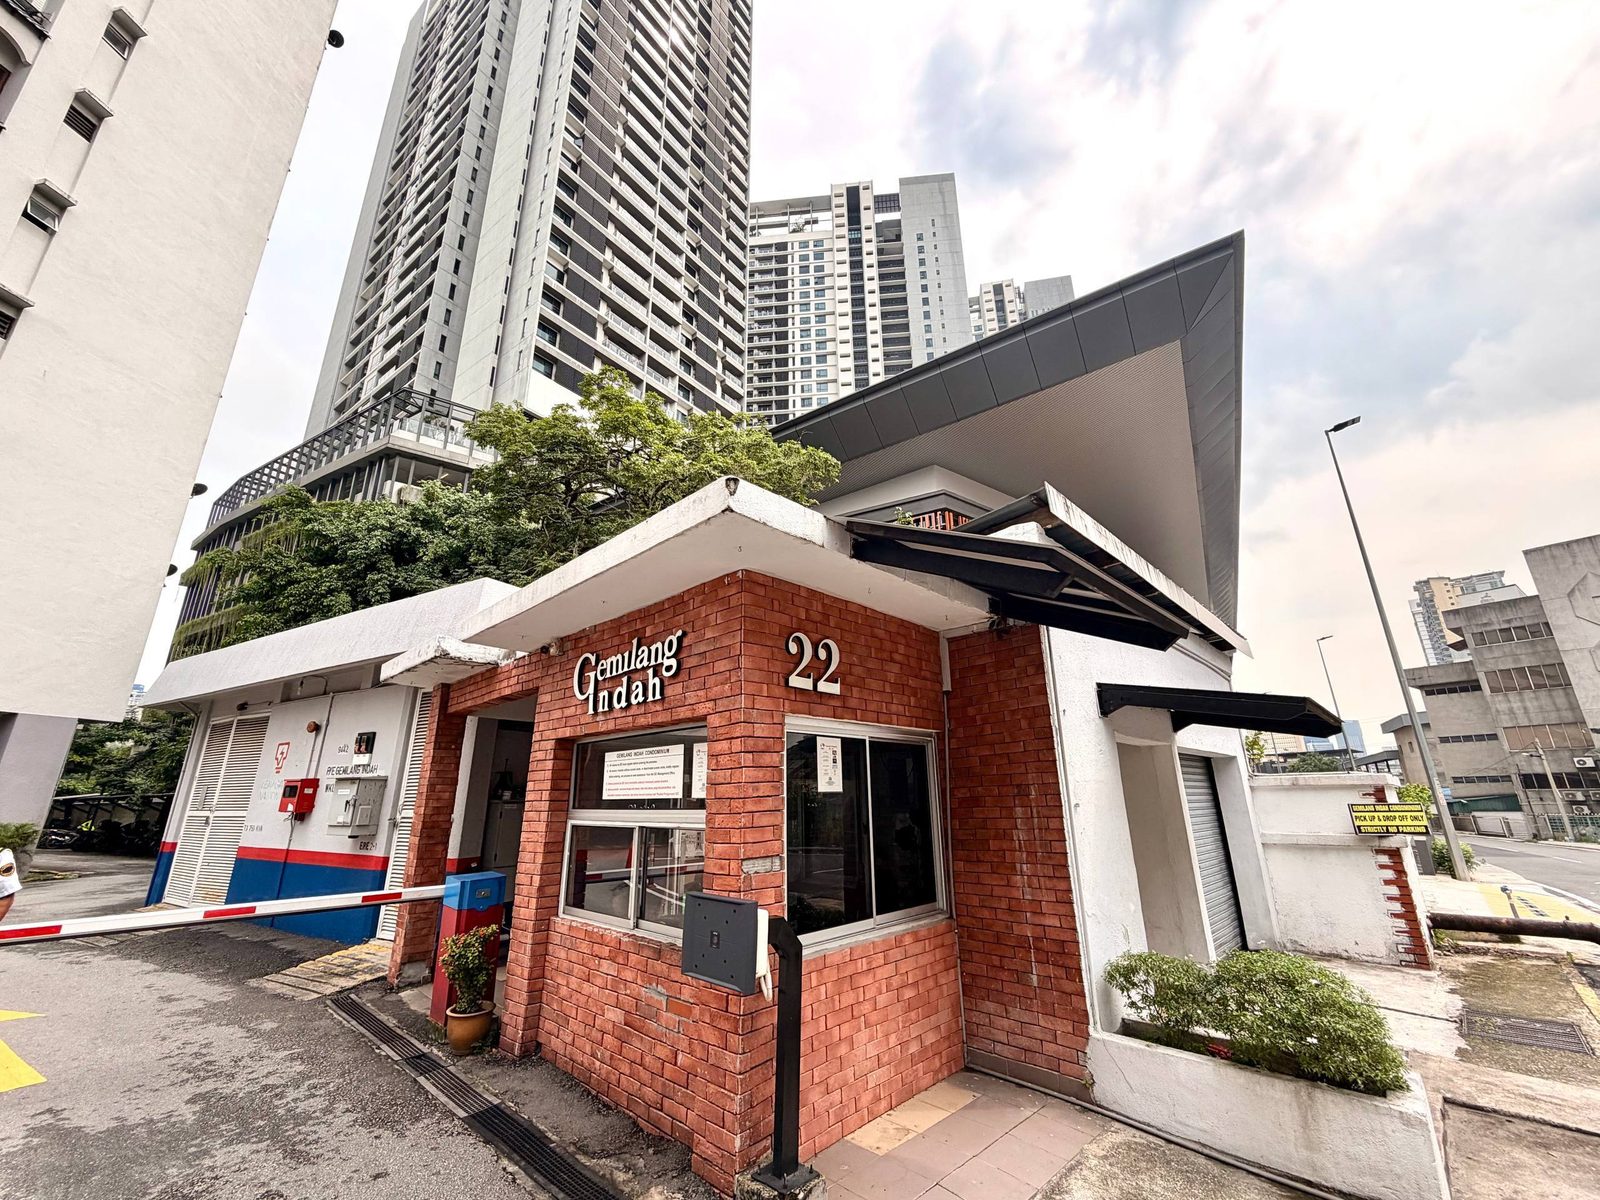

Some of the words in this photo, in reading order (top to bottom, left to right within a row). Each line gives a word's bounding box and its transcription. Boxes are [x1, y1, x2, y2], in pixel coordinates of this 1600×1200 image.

[572, 628, 683, 701] Gemilang
[788, 632, 841, 695] 22
[587, 669, 662, 716] Indah
[644, 748, 670, 756] CONDOMINIUM
